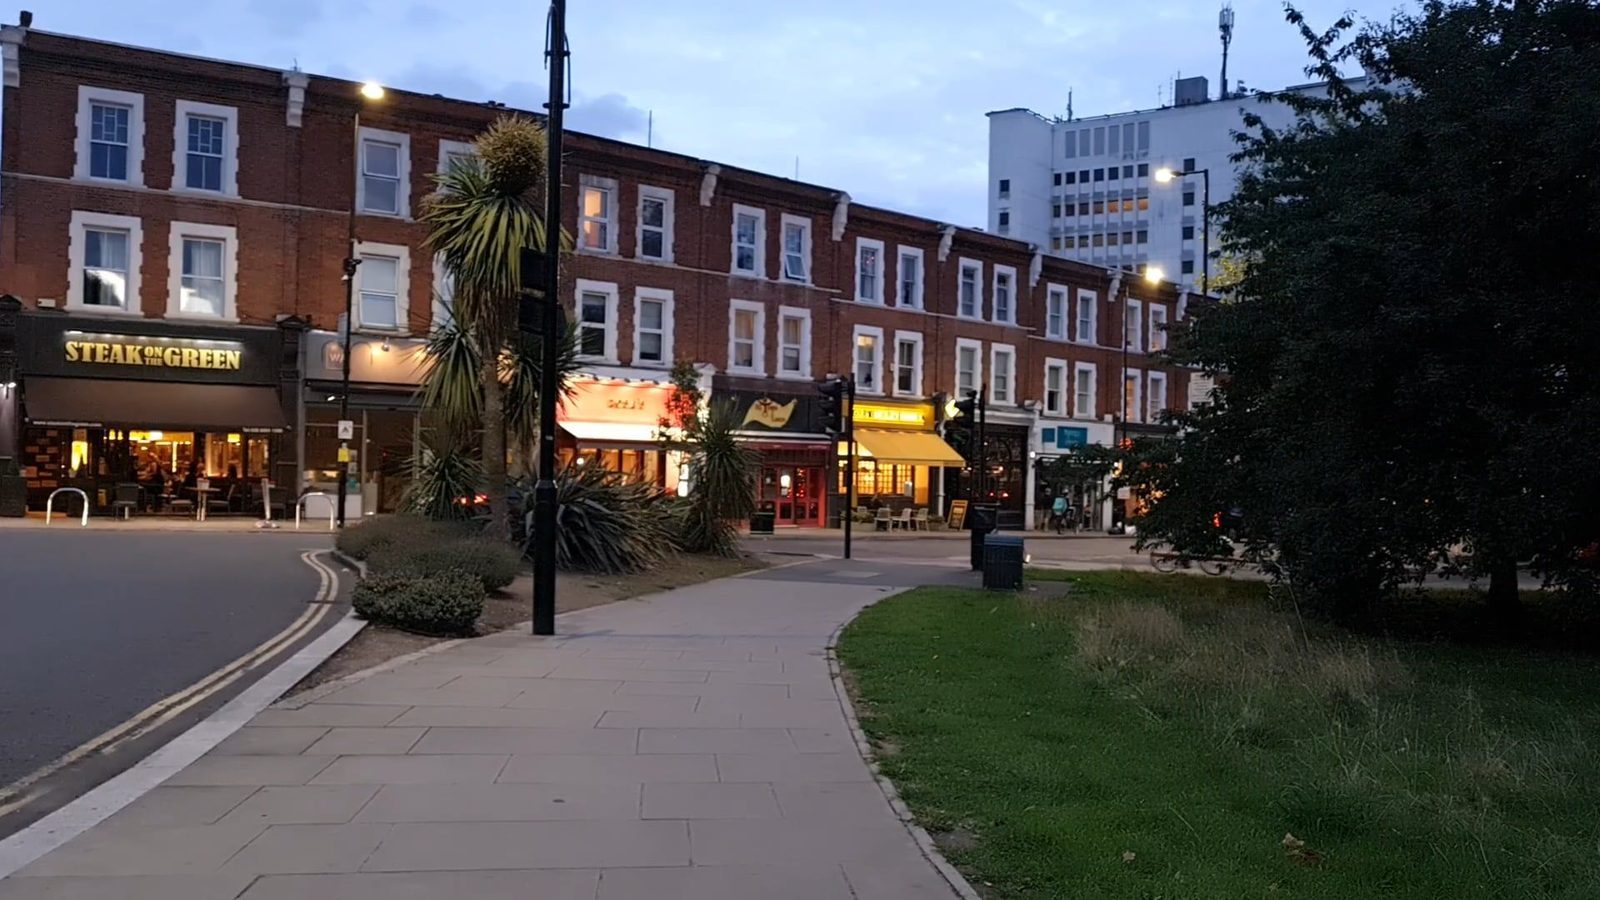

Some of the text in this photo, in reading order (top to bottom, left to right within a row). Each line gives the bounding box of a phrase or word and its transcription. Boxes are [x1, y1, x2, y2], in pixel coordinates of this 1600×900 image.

[65, 341, 241, 370] STEAK ON THE GREEN
